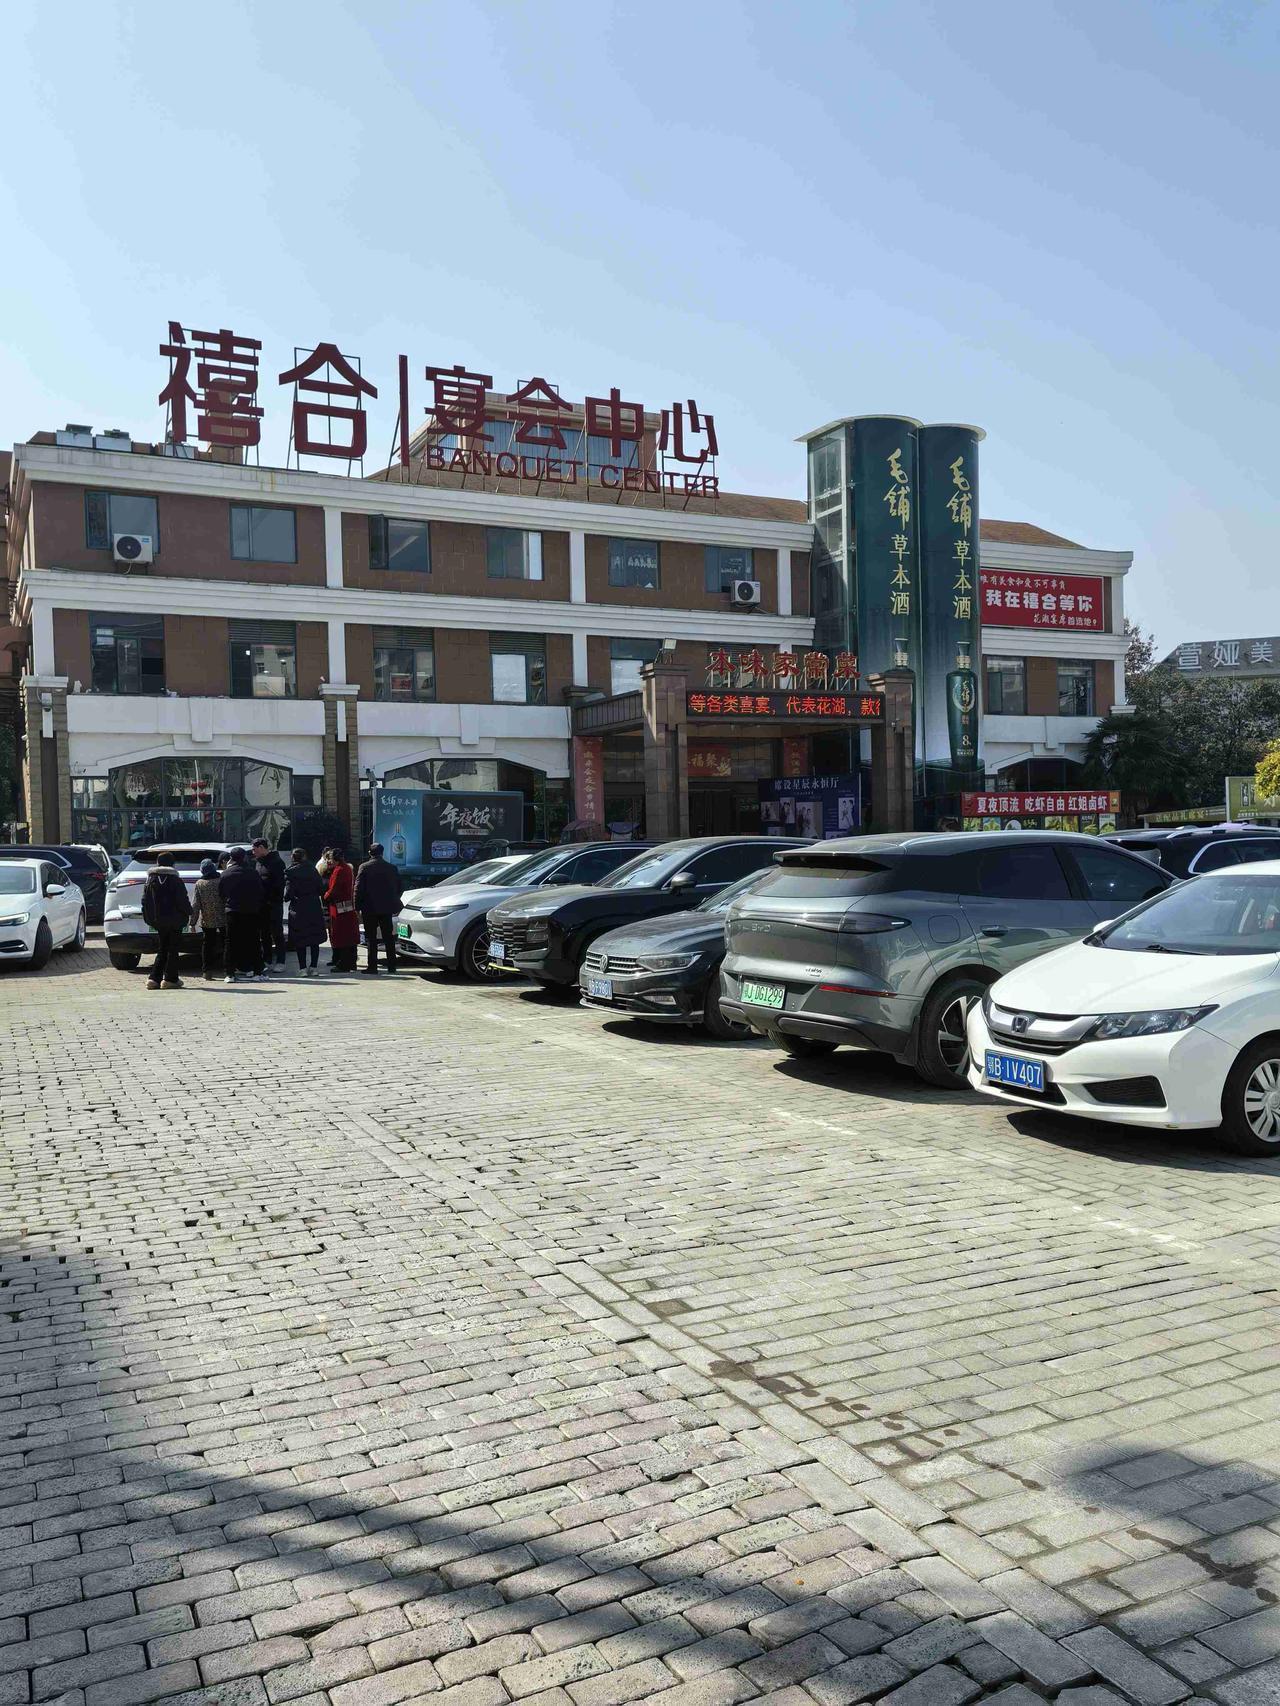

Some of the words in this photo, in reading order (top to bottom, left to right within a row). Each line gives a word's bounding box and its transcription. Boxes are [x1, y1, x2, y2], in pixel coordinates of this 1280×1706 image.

[159, 321, 378, 458] 禧合
[424, 365, 719, 463] 宴会中心
[426, 445, 583, 484] BANQUET
[600, 464, 720, 499] CENTER
[986, 589, 1093, 612] 我在禧合等你
[704, 648, 861, 680] 本味家常菜
[774, 777, 840, 791] 席设星辰永恒厅
[439, 802, 495, 832] 年夜饭
[977, 797, 1020, 813] 夏夜顶流
[1024, 797, 1065, 812] 吃虾自由
[1068, 795, 1108, 811] 红姐卤虾
